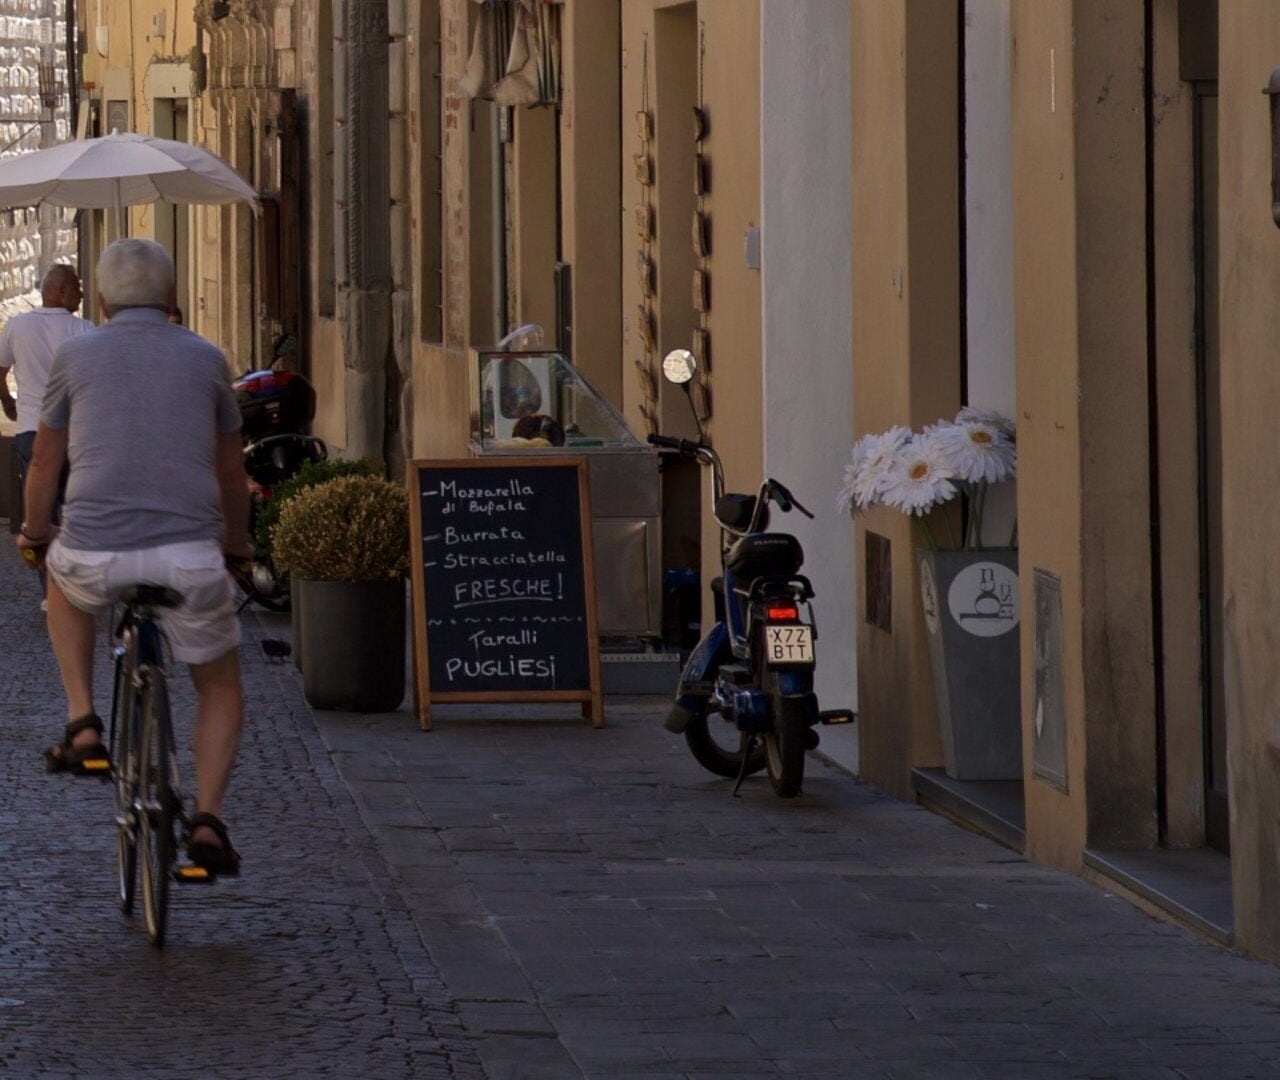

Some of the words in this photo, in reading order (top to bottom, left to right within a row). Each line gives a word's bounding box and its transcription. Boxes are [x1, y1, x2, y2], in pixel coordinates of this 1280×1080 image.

[440, 479, 534, 500] Mozzarella
[442, 502, 456, 514] di
[469, 500, 527, 516] Bufala
[445, 526, 526, 546] Burrata
[443, 551, 567, 569] Stracciatella
[468, 630, 538, 650] Taralli
[772, 628, 806, 644] X7Z
[773, 644, 807, 660] BTT
